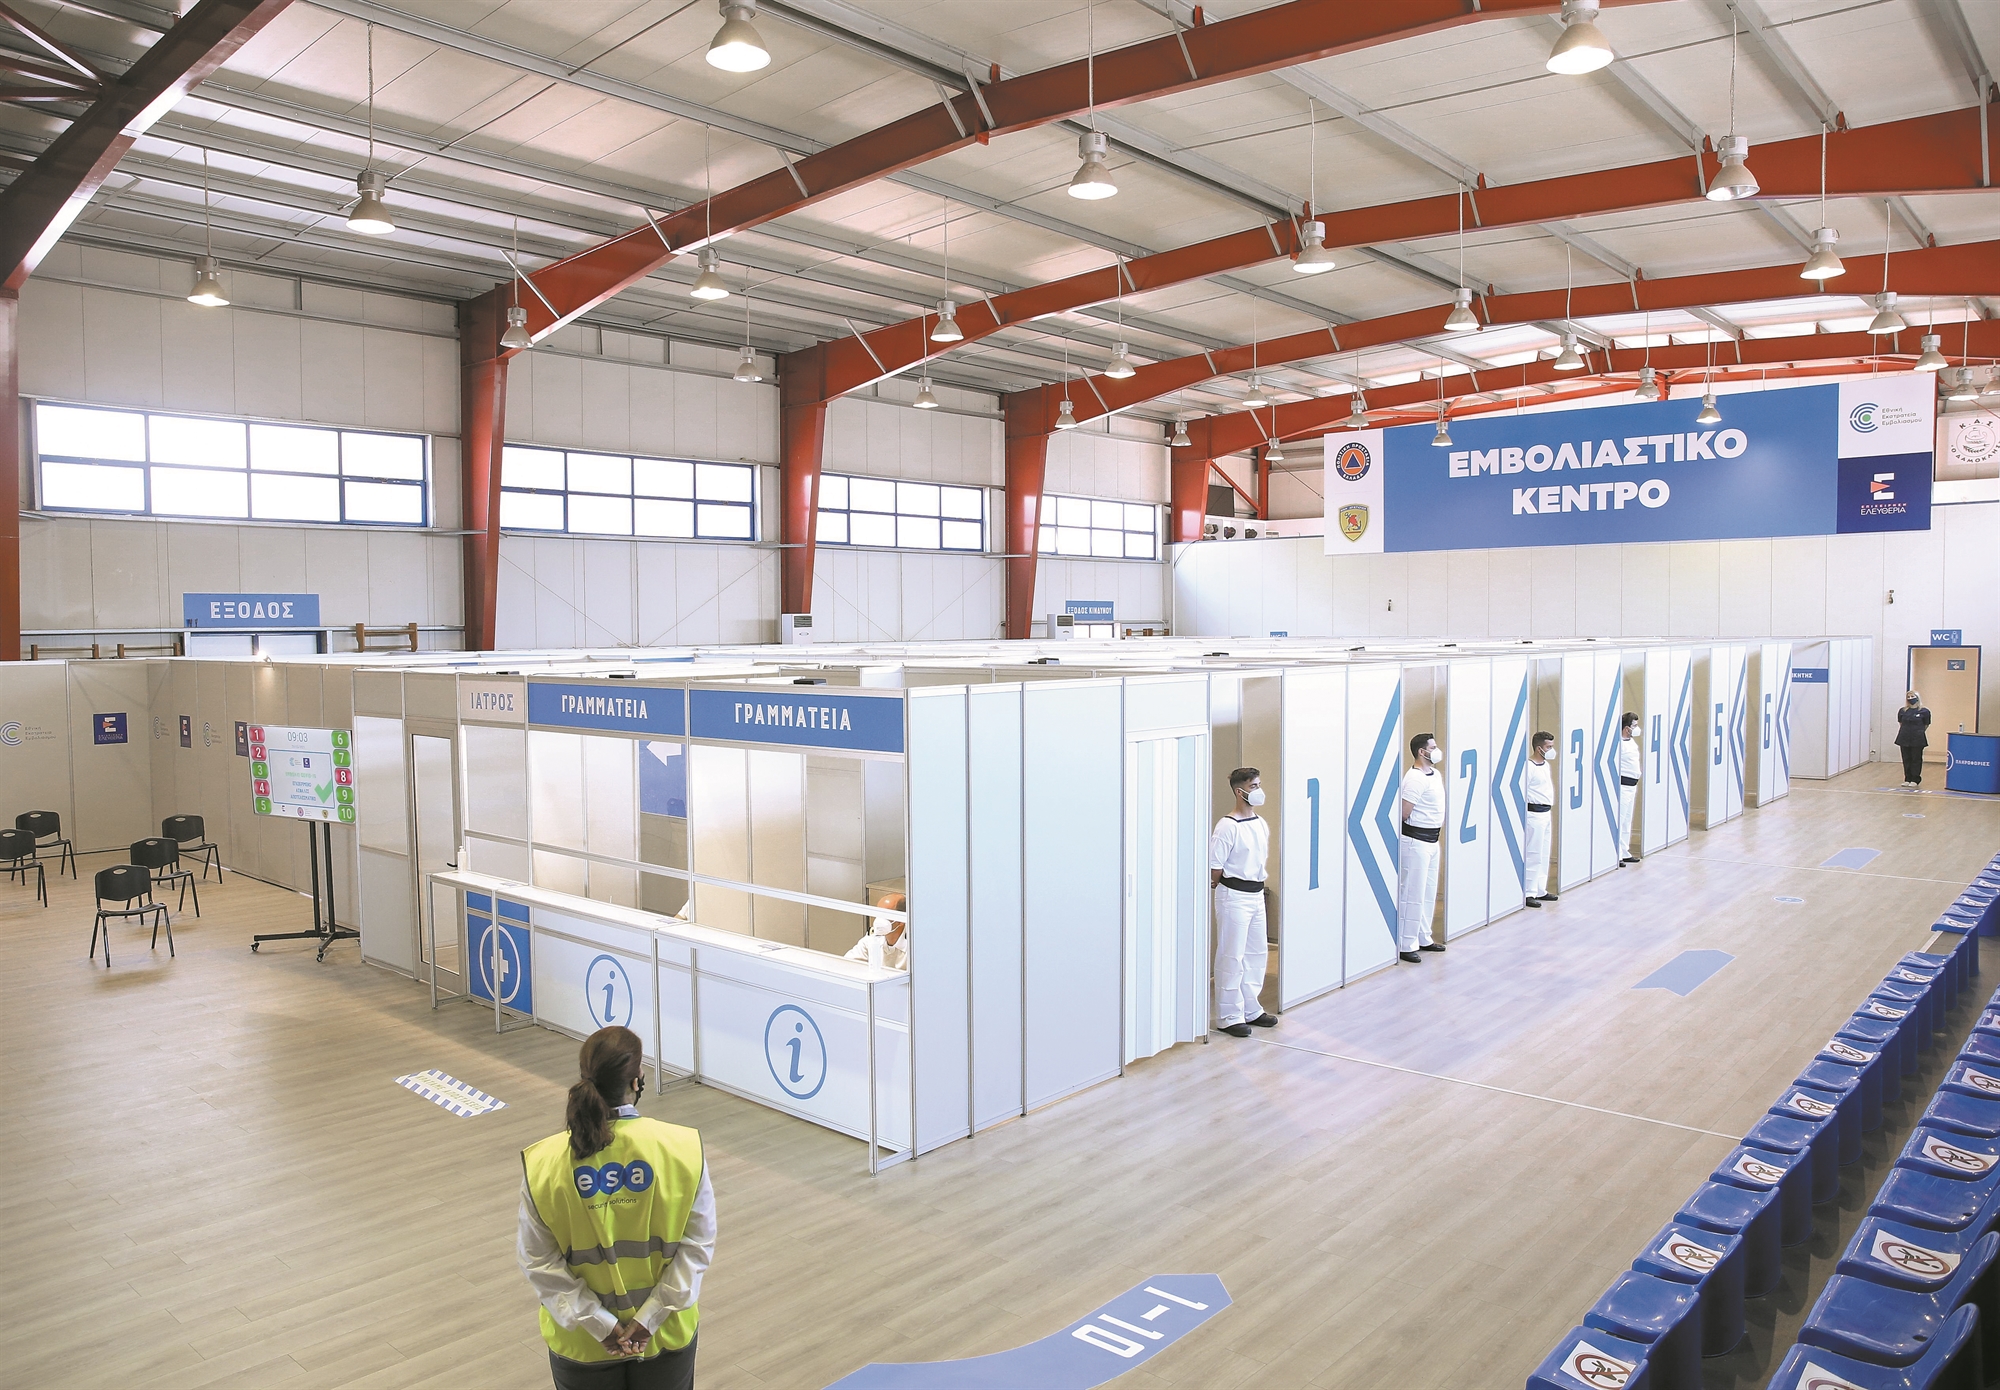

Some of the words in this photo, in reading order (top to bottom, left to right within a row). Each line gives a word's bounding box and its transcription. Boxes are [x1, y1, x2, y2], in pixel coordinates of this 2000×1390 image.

[1881, 417, 1922, 426] Εμβολιασμού
[1449, 428, 1748, 478] ΕΜΒΟΛΙΑΣΤΙΚΟ
[1512, 479, 1670, 515] ΚΕΝΤΡΟ
[1860, 506, 1906, 516] ΕΛΕΥΘΕΡΙΑ
[210, 602, 294, 618] ΕΞΟΔΟΣ
[1067, 606, 1088, 614] ΕΞΟΔΟΣ
[1932, 633, 1950, 641] WC
[471, 692, 514, 711] ΙΑΤΡΟΣ
[561, 695, 648, 719] ΓΡΑΜΜΑΤΕΙΑ
[735, 703, 851, 731] ΓΡΑΜΜΑΤΕΙΑ
[1764, 693, 1771, 749] 6
[254, 730, 259, 740] 1
[288, 732, 308, 742] 09:03
[337, 734, 343, 745] 6
[1714, 703, 1723, 765] 5
[256, 747, 261, 757] 2
[1651, 714, 1661, 784] 4
[338, 752, 344, 763] 7
[257, 766, 263, 776] 3
[1570, 728, 1583, 810] 3
[340, 771, 347, 782] 8
[259, 783, 265, 793] 4
[342, 790, 347, 800] 9
[1459, 749, 1477, 844] 2
[261, 800, 266, 811] 5
[341, 808, 352, 819] 10
[1307, 777, 1320, 890] 1
[577, 1167, 645, 1191] esa
[588, 1201, 608, 1210] securit
[609, 1197, 637, 1205] solutions
[1071, 1285, 1209, 1358] 1-10
